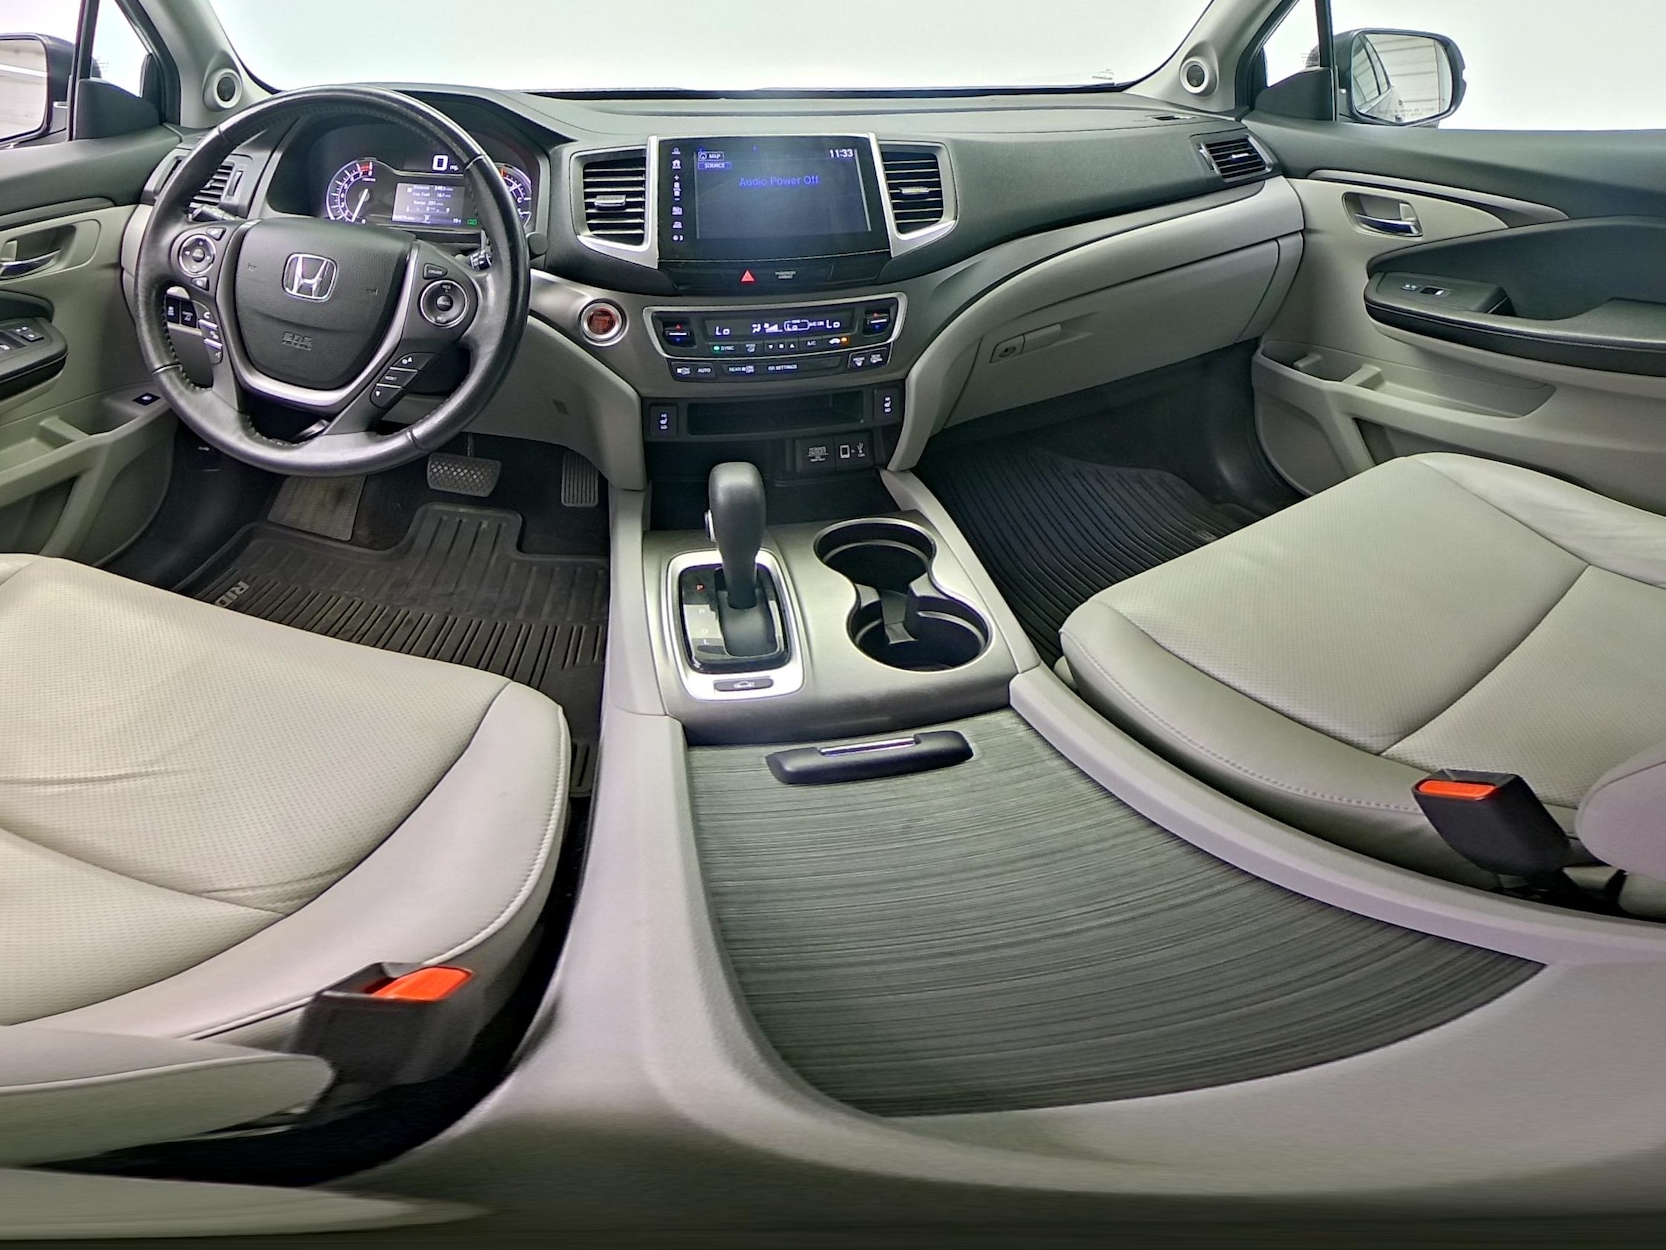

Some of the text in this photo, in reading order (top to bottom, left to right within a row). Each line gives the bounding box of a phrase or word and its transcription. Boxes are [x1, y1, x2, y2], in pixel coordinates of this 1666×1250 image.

[829, 149, 854, 158] 11:33
[432, 155, 449, 171] 0
[739, 175, 819, 187] Audio Power Off
[826, 319, 841, 329] Lo
[715, 325, 731, 336] Lo
